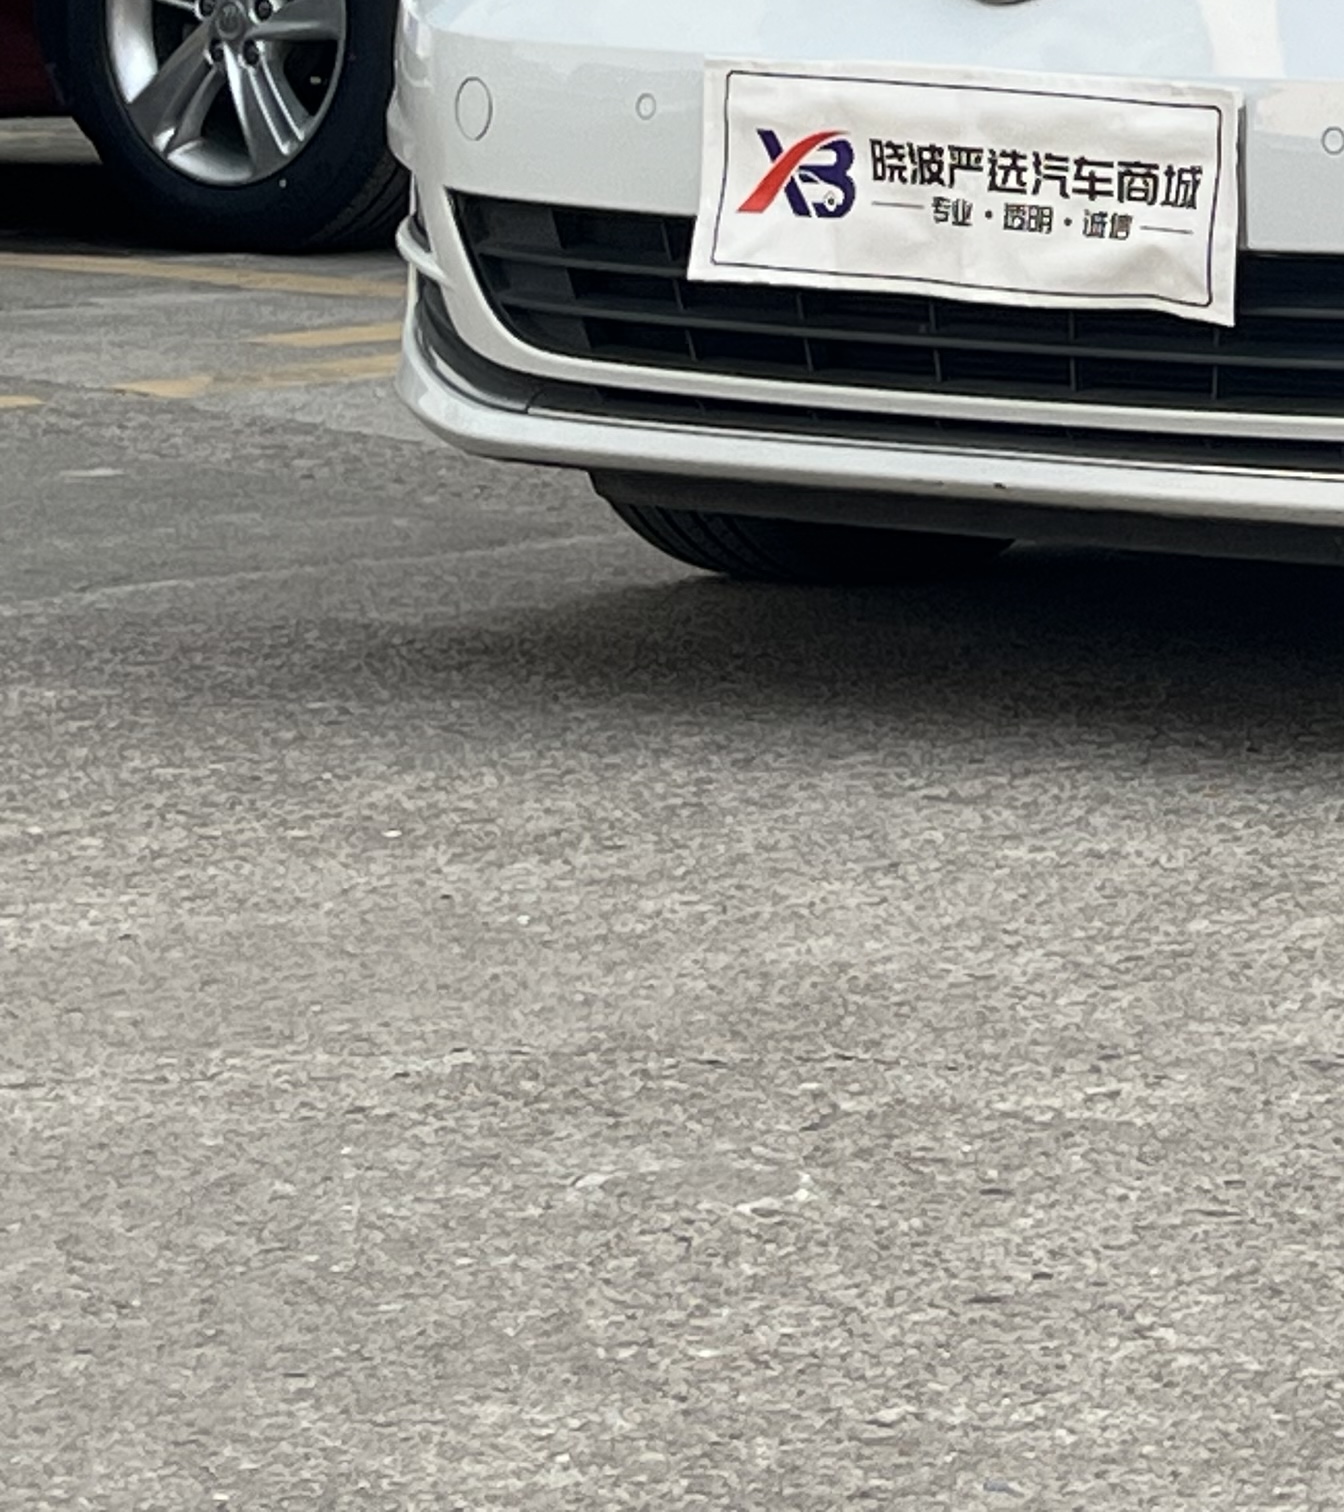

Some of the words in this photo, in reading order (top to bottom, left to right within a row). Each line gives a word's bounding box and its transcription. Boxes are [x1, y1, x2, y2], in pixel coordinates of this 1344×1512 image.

[868, 138, 1203, 210] 晓波严选汽车商城
